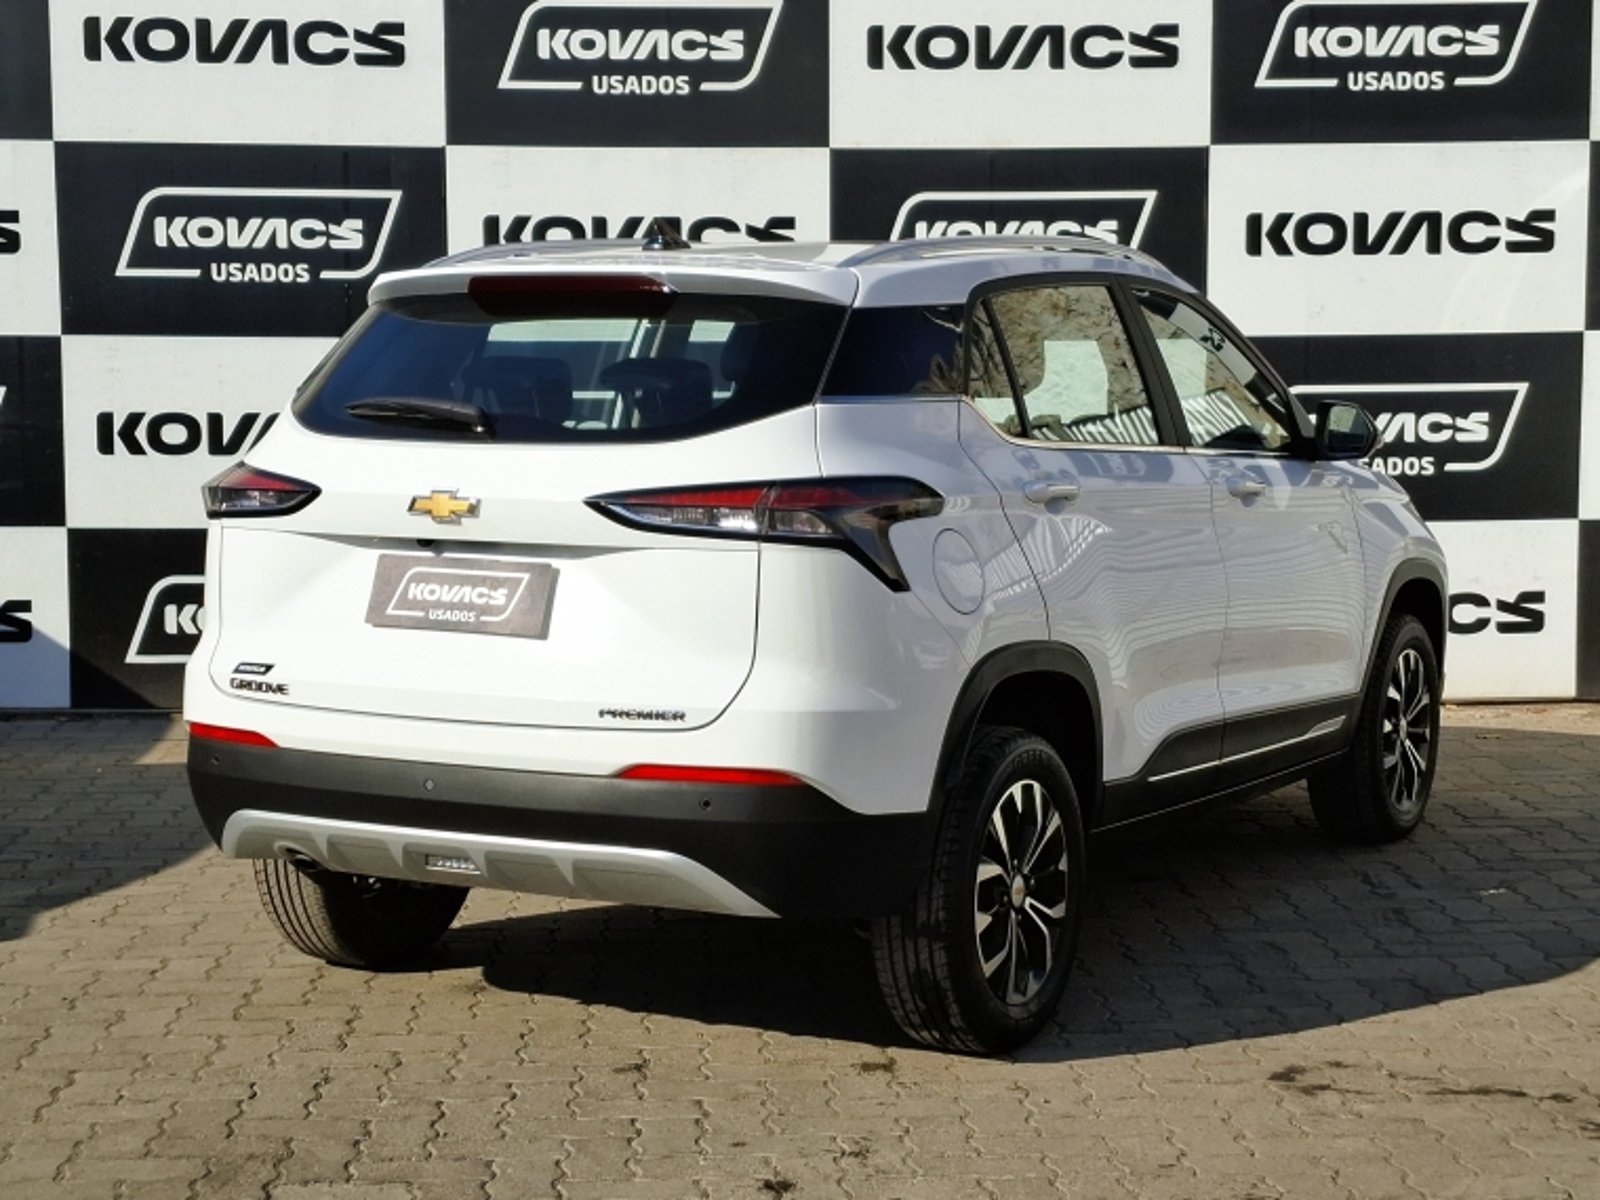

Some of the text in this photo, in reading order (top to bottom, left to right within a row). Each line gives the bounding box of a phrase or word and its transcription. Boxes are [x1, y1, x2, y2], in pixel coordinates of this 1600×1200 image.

[84, 16, 405, 67] KOVACS
[537, 28, 744, 61] KOVACS
[867, 23, 1180, 70] KOVACS
[1293, 24, 1500, 57] KOVACS
[592, 75, 690, 95] USADOS
[1347, 71, 1445, 91] USADOS
[153, 216, 364, 250] KOVACS
[1245, 209, 1556, 257] KOVACS
[210, 262, 310, 283] USADOS
[96, 411, 281, 456] KOV
[1358, 456, 1436, 476] ADOS
[407, 582, 509, 606] KOVACS
[429, 608, 477, 623] USADOS
[230, 677, 289, 696] GROOVE
[598, 708, 686, 721] PREMIER
